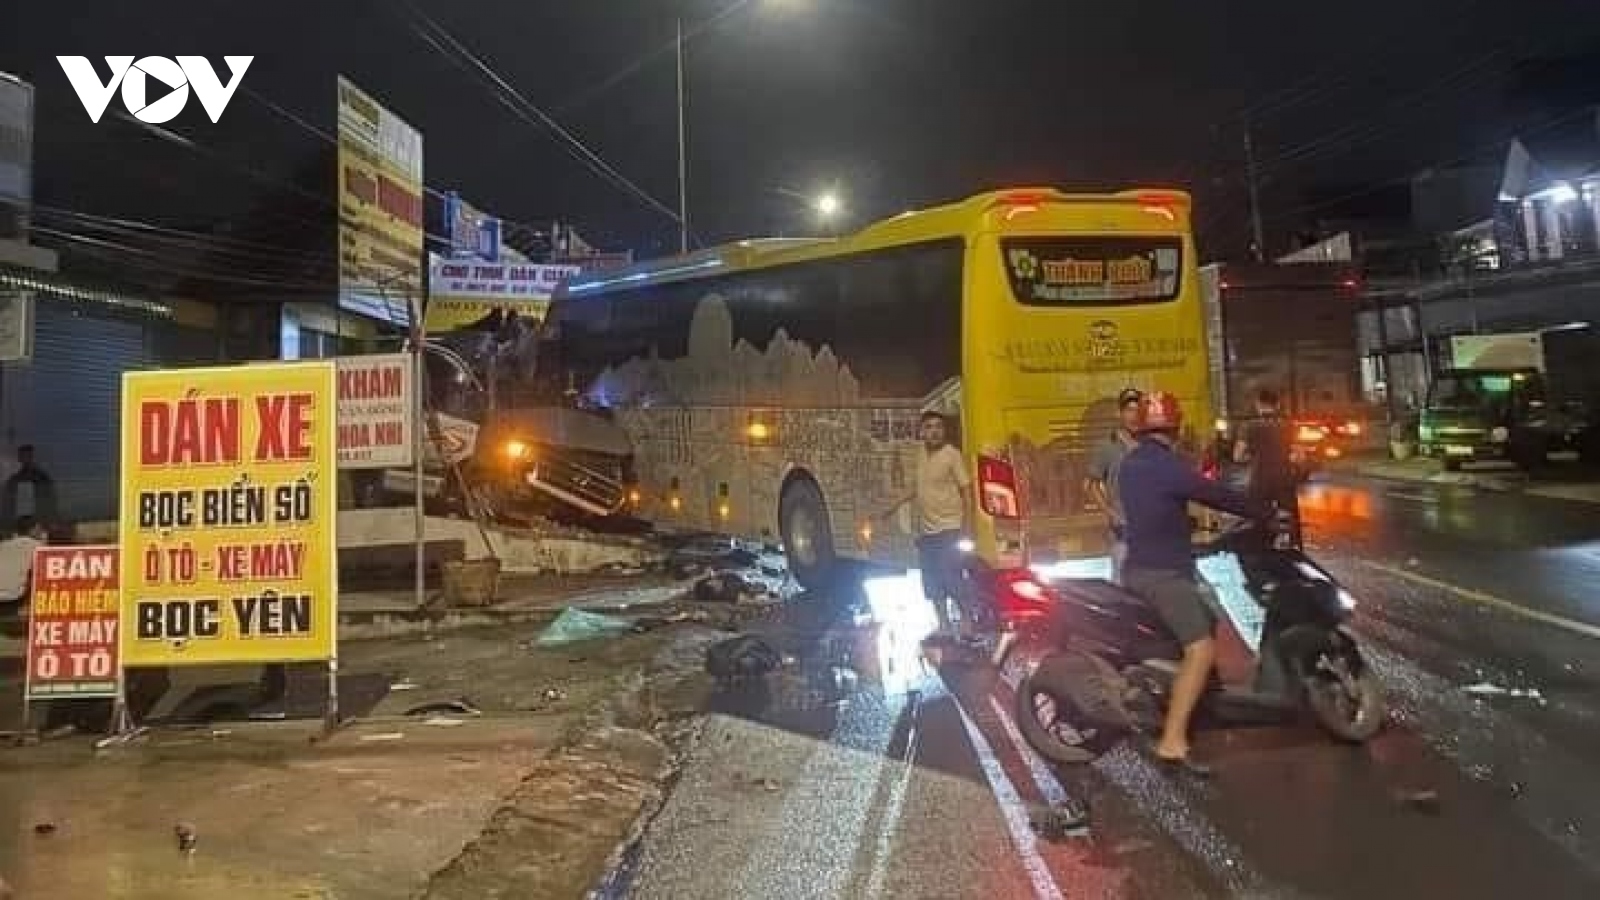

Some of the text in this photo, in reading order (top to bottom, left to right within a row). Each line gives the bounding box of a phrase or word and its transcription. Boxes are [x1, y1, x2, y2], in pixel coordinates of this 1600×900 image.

[255, 393, 314, 460] XE
[139, 471, 318, 536] BỌC BIỂN SỐ
[46, 551, 112, 581] BÁN
[145, 543, 160, 582] Ô
[168, 542, 194, 582] TÔ
[217, 546, 250, 579] XE
[251, 537, 306, 578] MÁY
[35, 616, 117, 646] XE MÁY
[137, 589, 311, 648] BỌC YÊN
[37, 647, 111, 678] Ô TÔ
